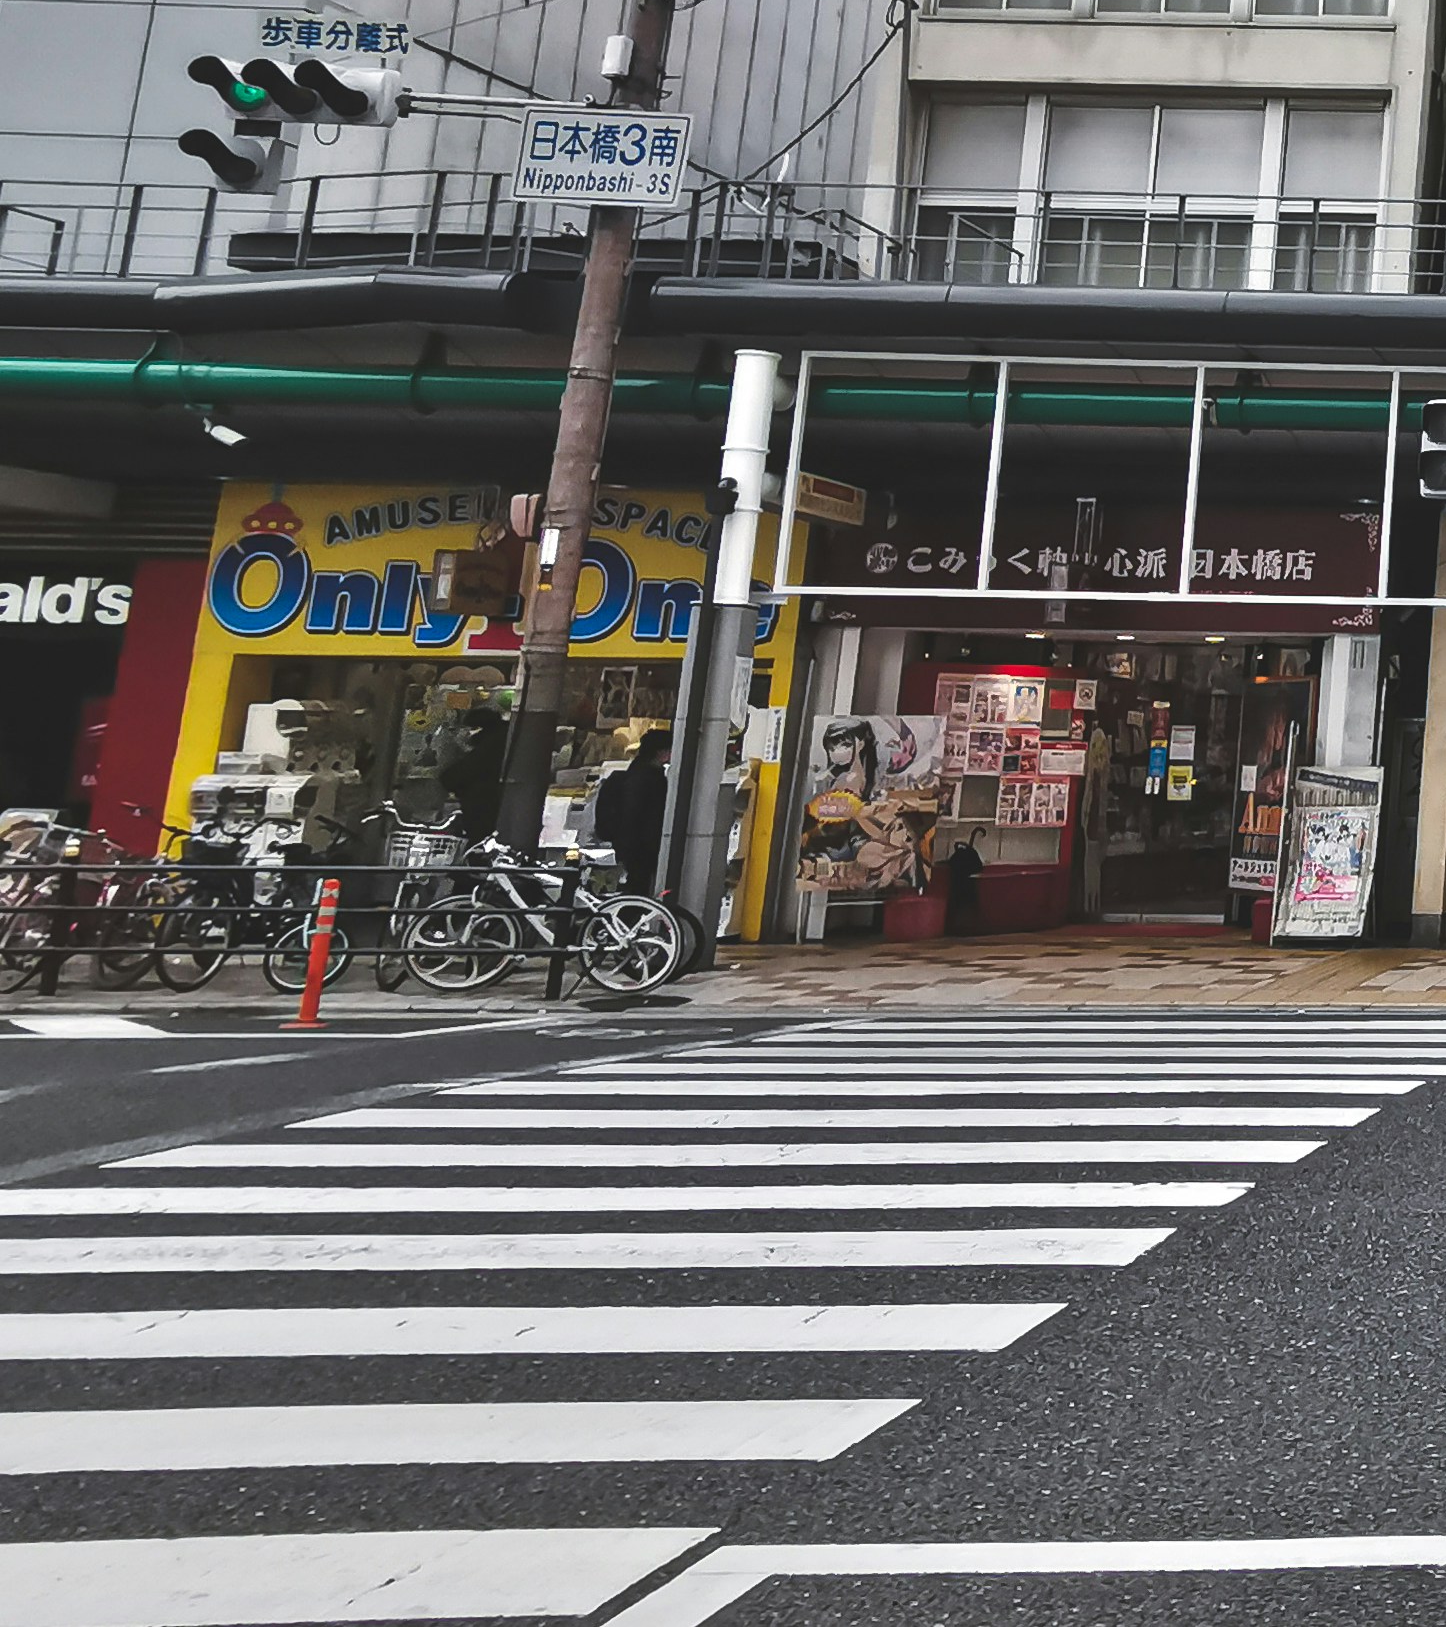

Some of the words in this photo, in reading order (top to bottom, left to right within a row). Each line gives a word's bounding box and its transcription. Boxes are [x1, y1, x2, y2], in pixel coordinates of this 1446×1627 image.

[261, 16, 410, 55] 歩車分離式
[528, 117, 683, 169] 日本橋3南
[1190, 548, 1318, 582] 日本橋店
[568, 537, 780, 645] On
